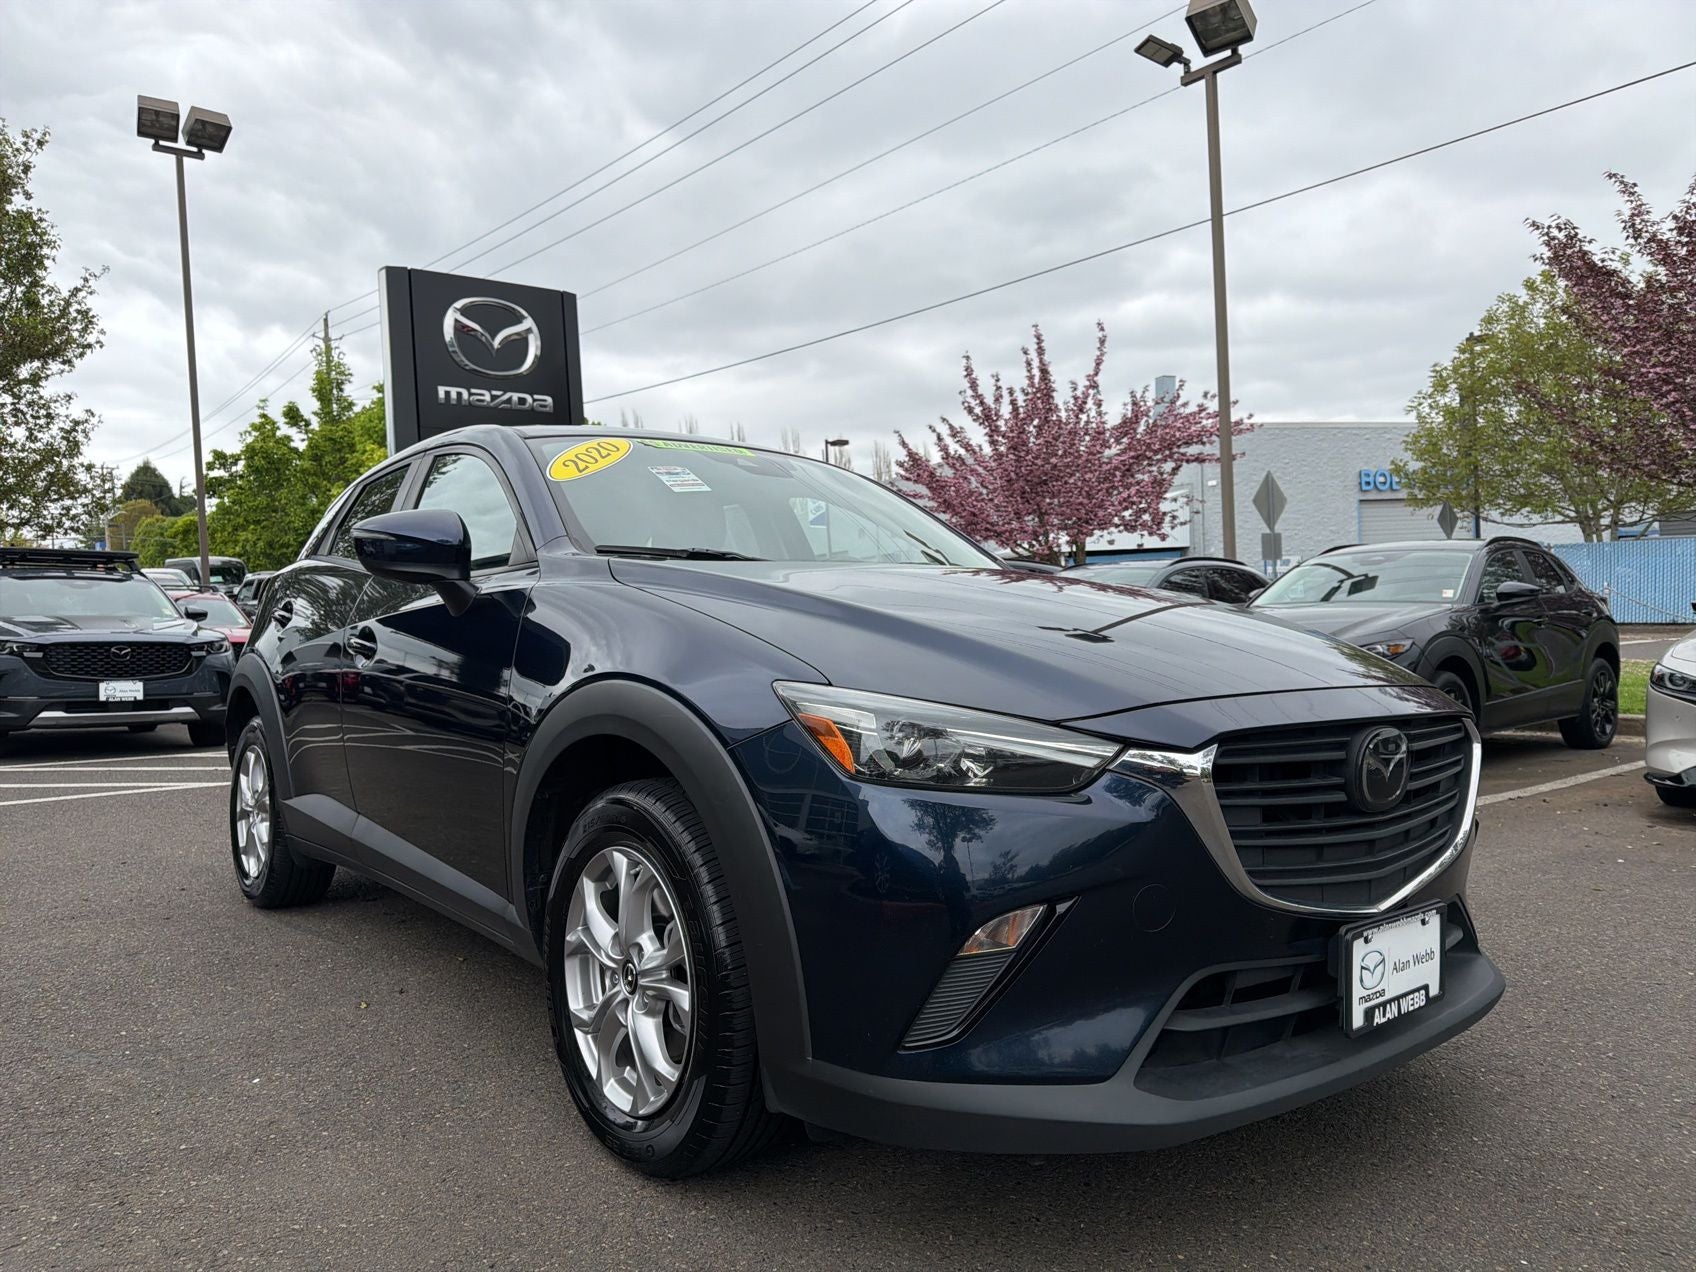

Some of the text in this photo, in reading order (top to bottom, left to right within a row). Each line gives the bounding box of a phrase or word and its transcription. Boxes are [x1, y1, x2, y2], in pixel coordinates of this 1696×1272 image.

[437, 385, 554, 413] mazda
[562, 441, 620, 473] 2020
[1392, 948, 1435, 975] Alan Webb
[1359, 988, 1386, 1006] mazda
[1373, 989, 1426, 1026] ALAN WEBB
